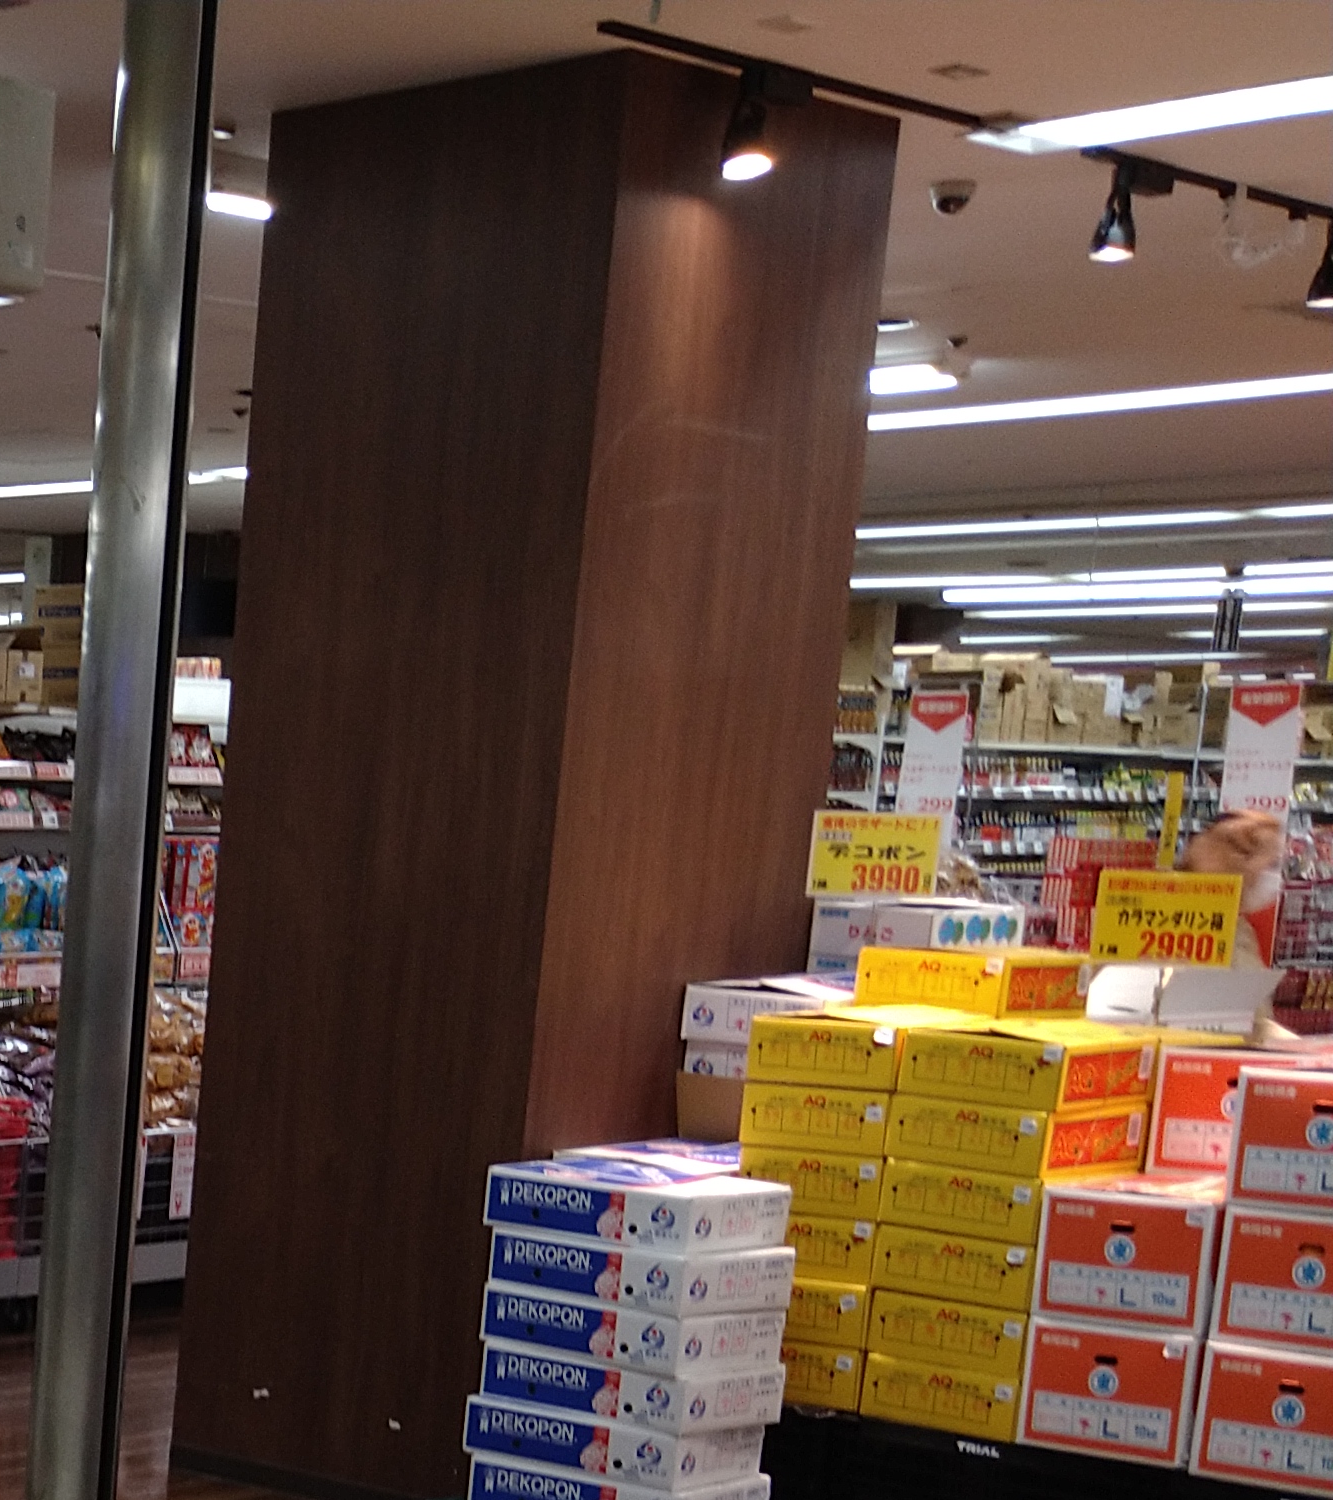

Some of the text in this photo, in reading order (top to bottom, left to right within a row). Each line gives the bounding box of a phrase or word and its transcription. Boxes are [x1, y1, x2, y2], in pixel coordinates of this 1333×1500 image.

[828, 842, 926, 861] デコポン
[512, 1180, 593, 1207] DEKOPON
[515, 1242, 591, 1269] DEKOPON
[507, 1299, 585, 1327] DEKOPON
[507, 1358, 587, 1387] DEKOPON
[491, 1412, 575, 1442] DEKOPON
[957, 1440, 1000, 1459] TRIAL
